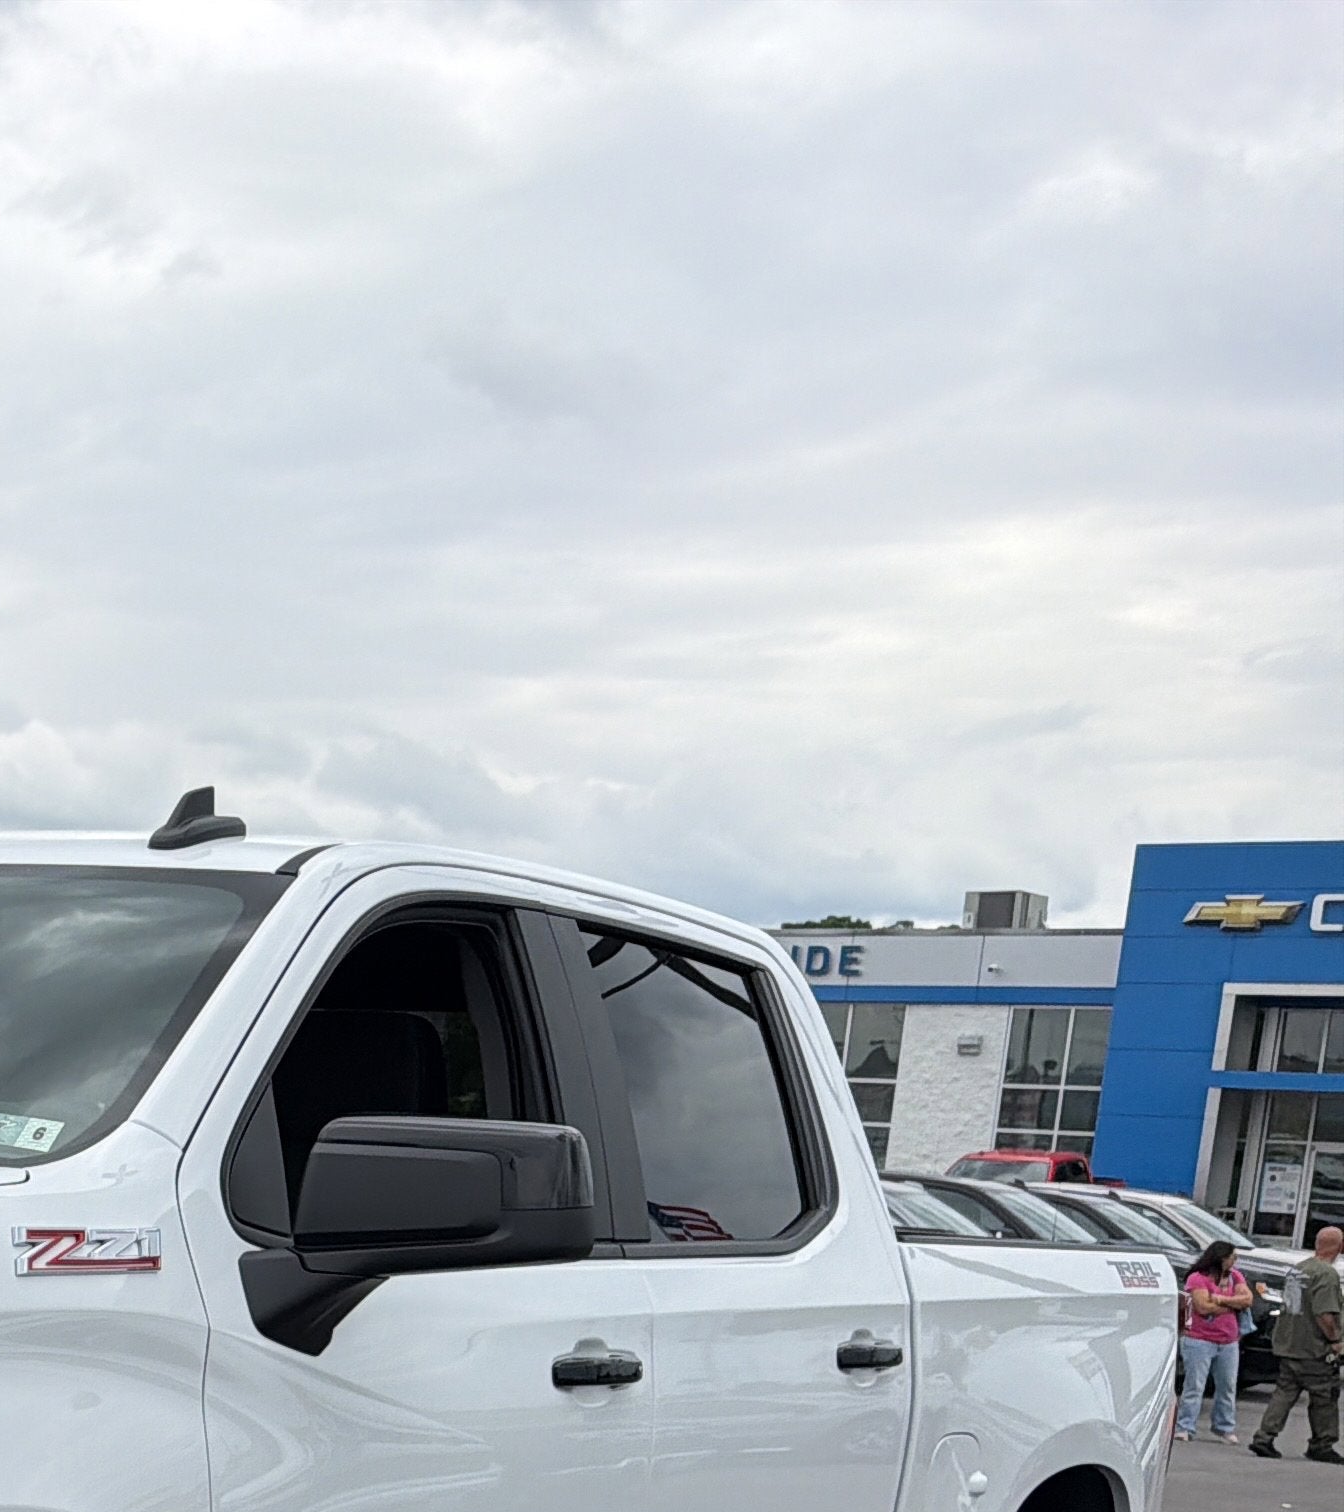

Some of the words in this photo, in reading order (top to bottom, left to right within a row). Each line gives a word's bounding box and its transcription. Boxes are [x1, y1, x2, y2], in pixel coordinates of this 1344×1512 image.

[32, 1126, 48, 1141] 6
[12, 1226, 162, 1277] Z71
[1106, 1260, 1162, 1277] TRAIL
[1120, 1275, 1160, 1288] BOSS
